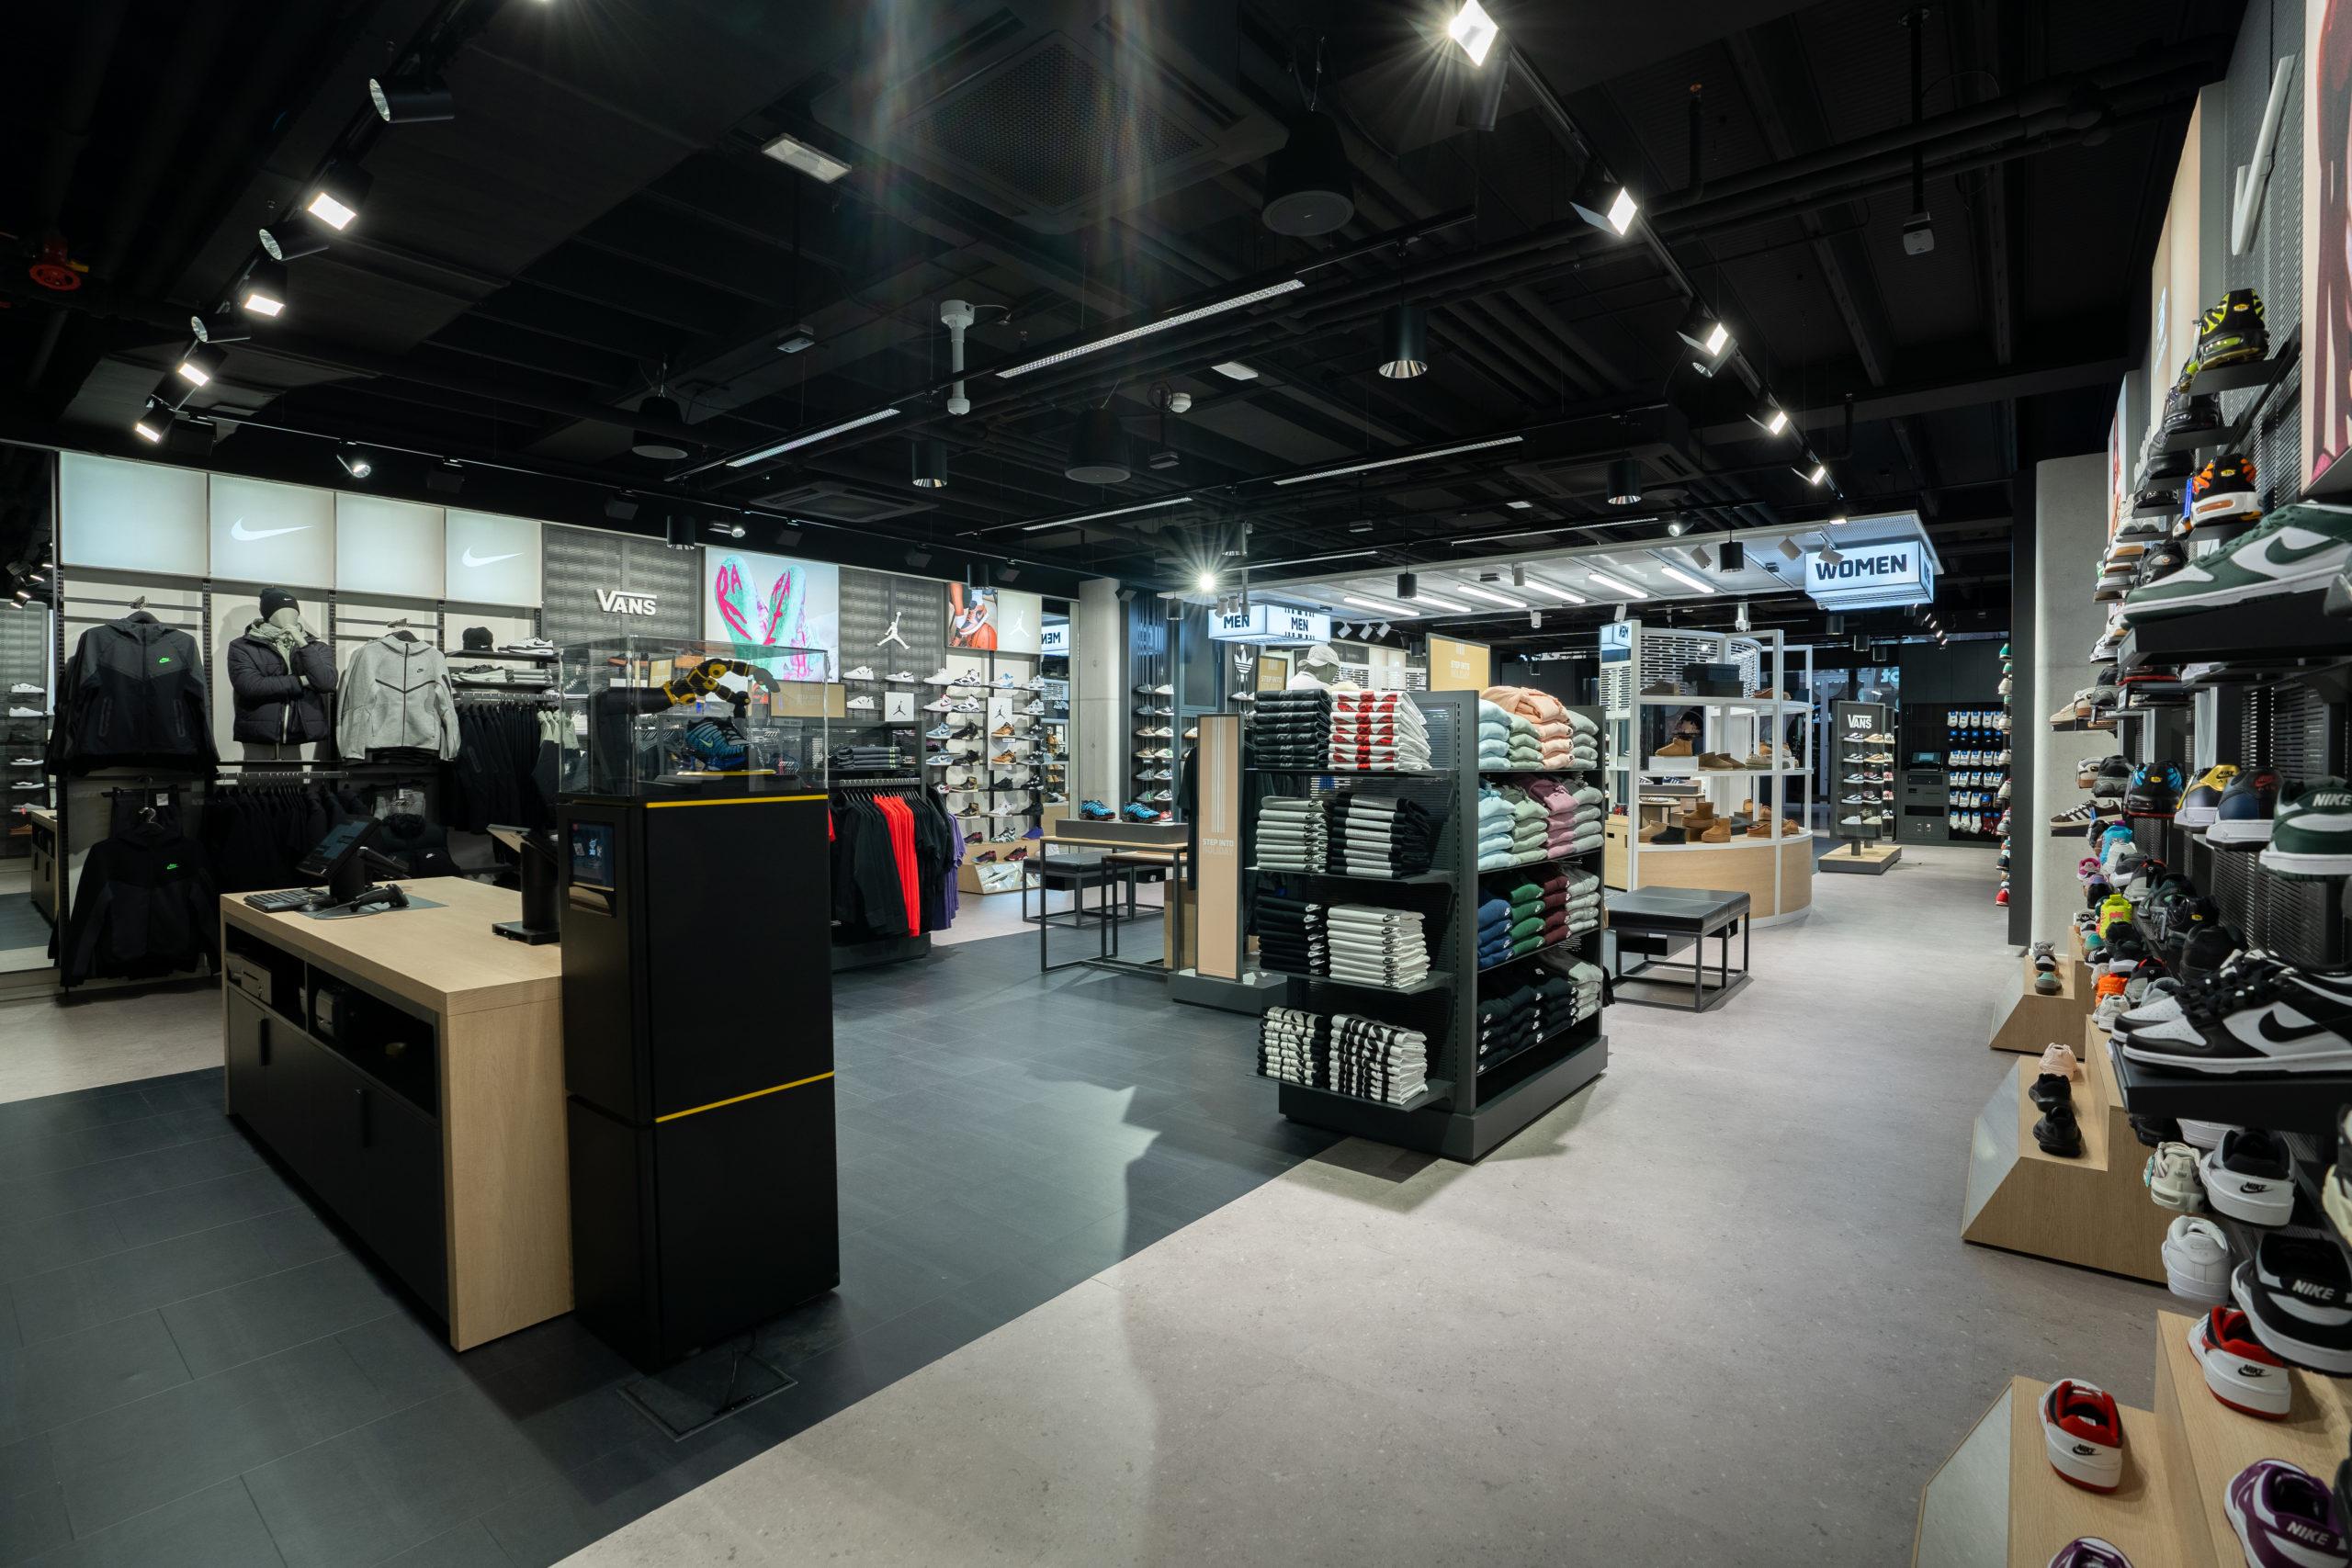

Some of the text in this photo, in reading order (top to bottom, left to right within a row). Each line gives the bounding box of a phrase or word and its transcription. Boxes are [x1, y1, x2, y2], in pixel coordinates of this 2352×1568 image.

[1815, 554, 1907, 580] WOMEN
[596, 589, 657, 615] VANS
[1224, 615, 1250, 628] MEN
[1291, 617, 1308, 631] MEN
[1848, 715, 1872, 728] VANS
[2312, 794, 2352, 807] NIKE
[2291, 1280, 2335, 1300] NIKE
[2287, 1521, 2329, 1545] NIKE
